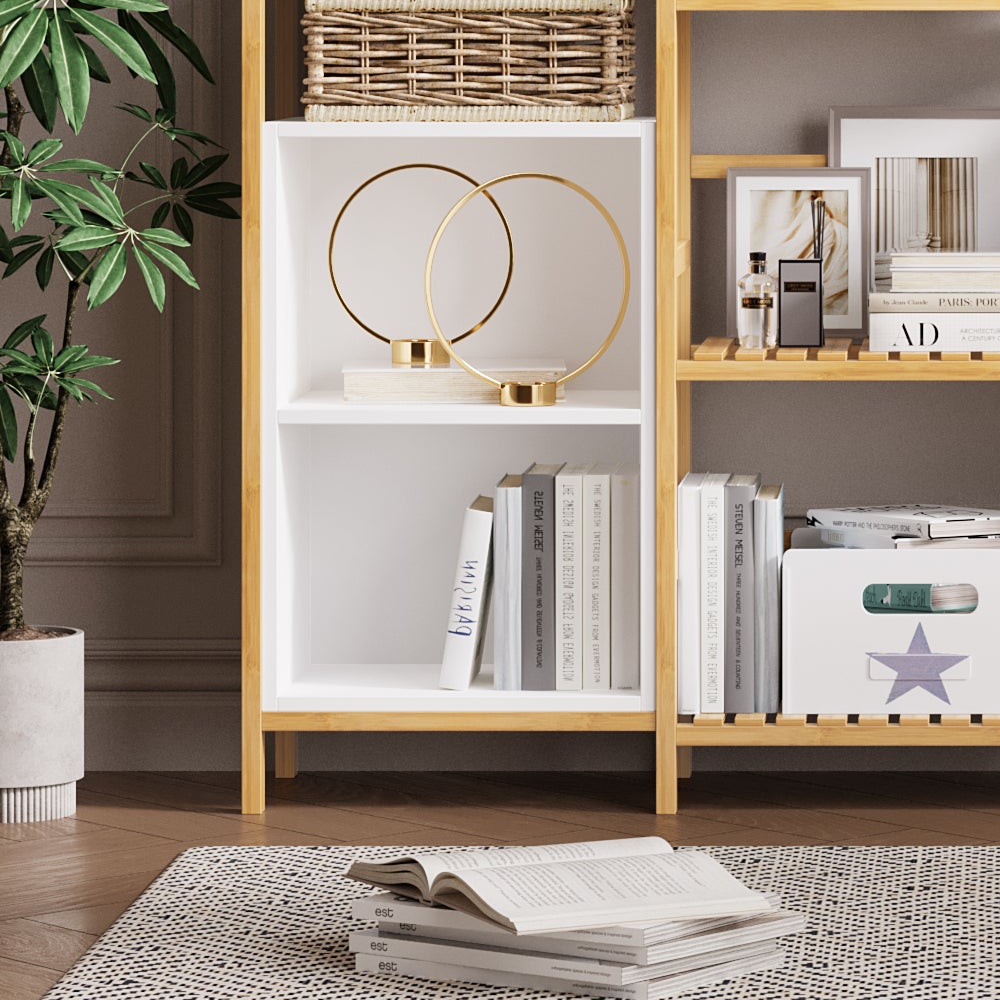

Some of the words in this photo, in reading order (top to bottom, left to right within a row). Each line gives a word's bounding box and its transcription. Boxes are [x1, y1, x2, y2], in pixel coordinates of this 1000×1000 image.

[891, 322, 939, 347] AD
[593, 483, 602, 495] THE
[707, 496, 719, 508] THE
[593, 499, 602, 527] SWEDISH
[734, 503, 744, 534] STEVEN
[707, 513, 719, 541] SWEDISH
[592, 531, 601, 562] INTERIOR
[734, 539, 744, 569] MEISEL
[707, 545, 719, 578] INTERIOR
[591, 565, 600, 589] DESIGN
[591, 592, 600, 620] GADGETS
[707, 581, 719, 607] DESIGN
[591, 624, 600, 641] FROM
[707, 610, 719, 639] GADGETS
[592, 643, 601, 684] EVERMOTION
[707, 642, 719, 660] FROM
[707, 662, 719, 704] EVERMOTION
[375, 908, 394, 918] est
[399, 922, 417, 932] est
[370, 941, 388, 952] est
[378, 961, 398, 972] est
